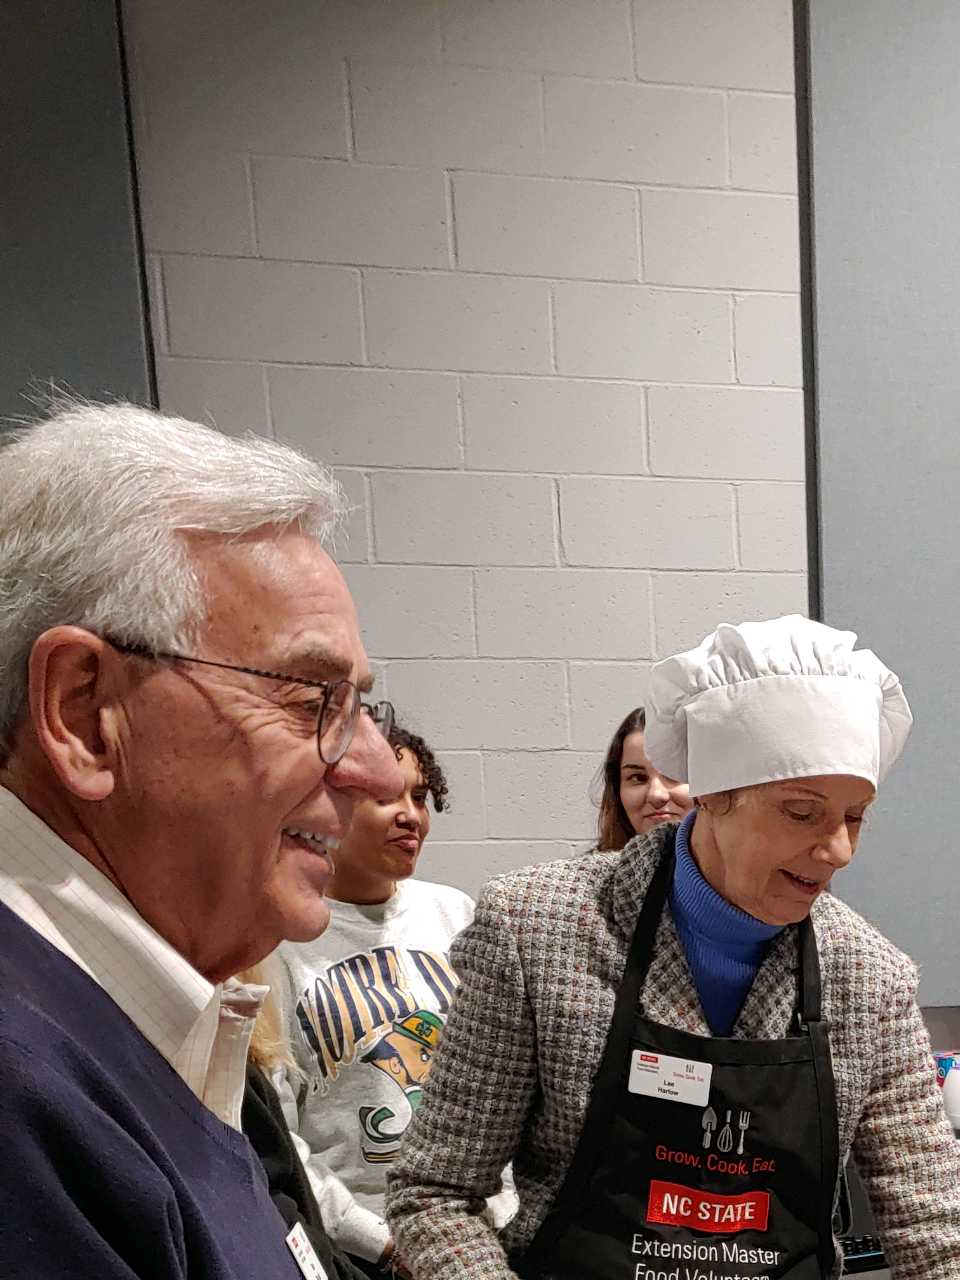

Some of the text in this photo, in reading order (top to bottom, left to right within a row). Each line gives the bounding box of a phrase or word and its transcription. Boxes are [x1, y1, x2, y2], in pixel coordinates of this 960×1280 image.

[295, 944, 420, 1079] NOTRE
[655, 1145, 776, 1175] Grow. Cook. Eat
[662, 1192, 757, 1223] NC STATE
[631, 1233, 781, 1266] Extension Master
